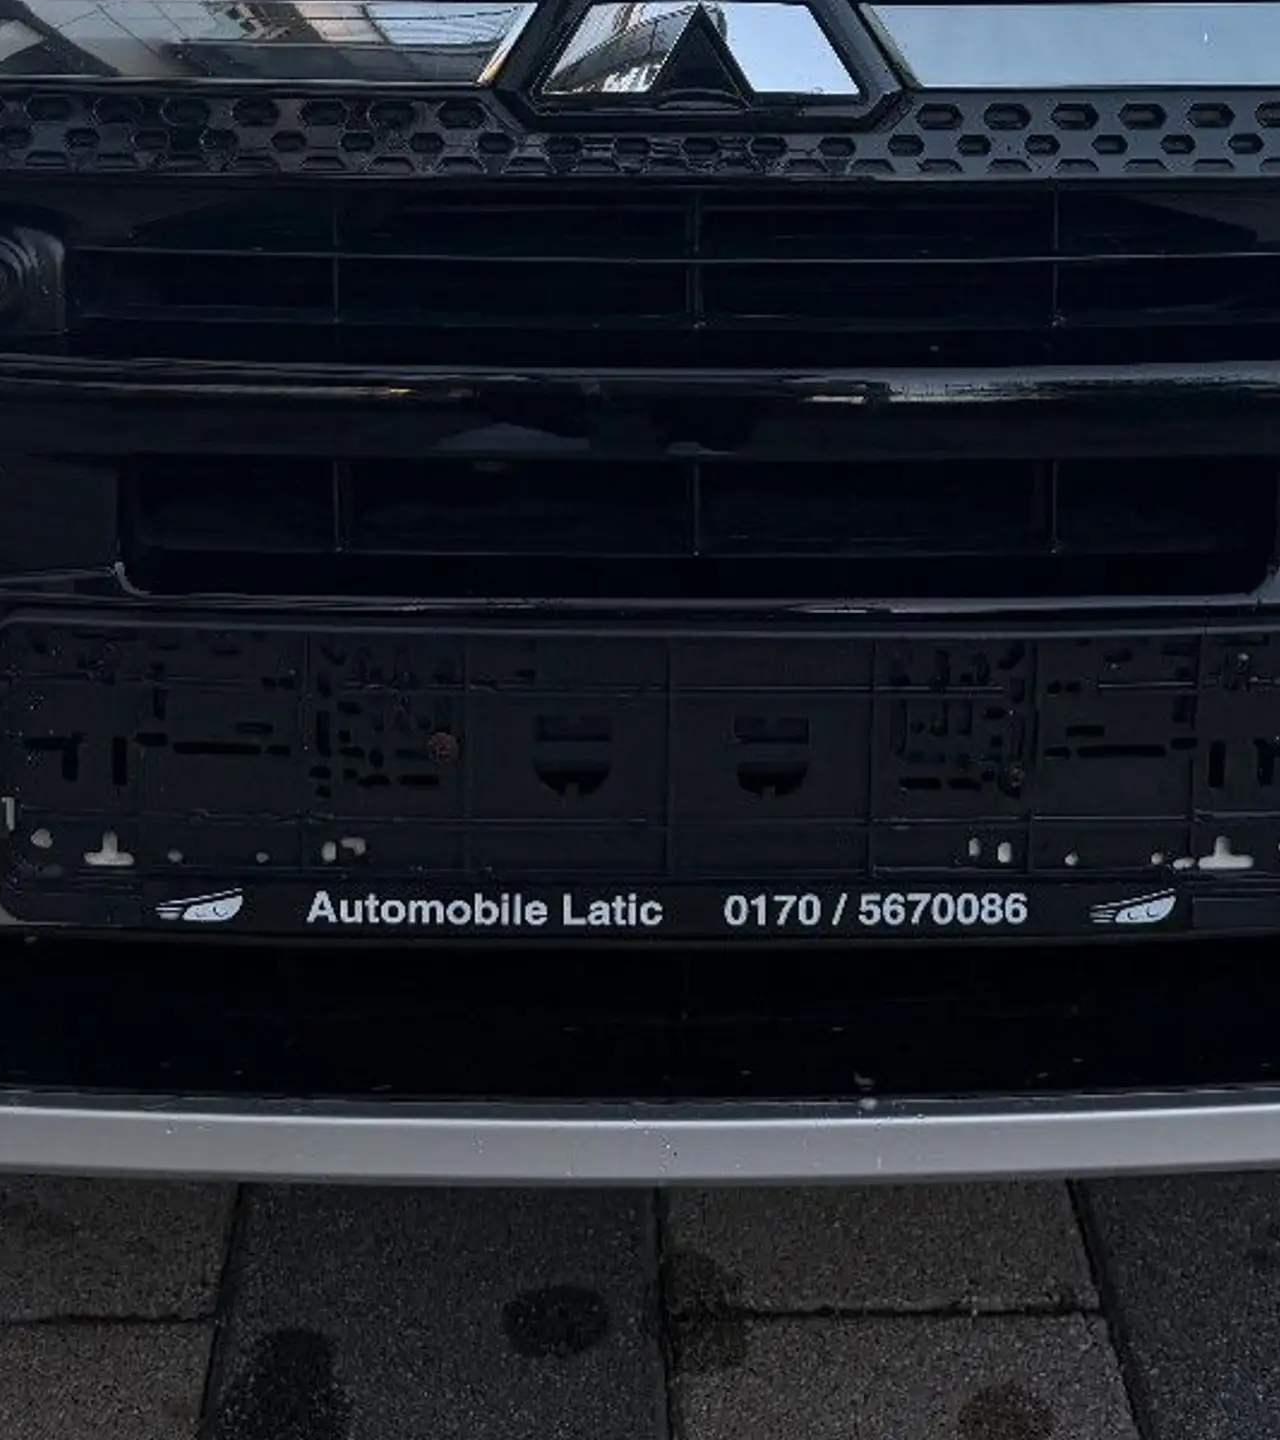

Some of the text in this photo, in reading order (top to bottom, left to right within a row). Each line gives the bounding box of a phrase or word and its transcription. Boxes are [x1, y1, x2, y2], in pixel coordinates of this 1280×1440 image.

[307, 891, 1028, 927] Automobile Latic 0170 / 5670086
